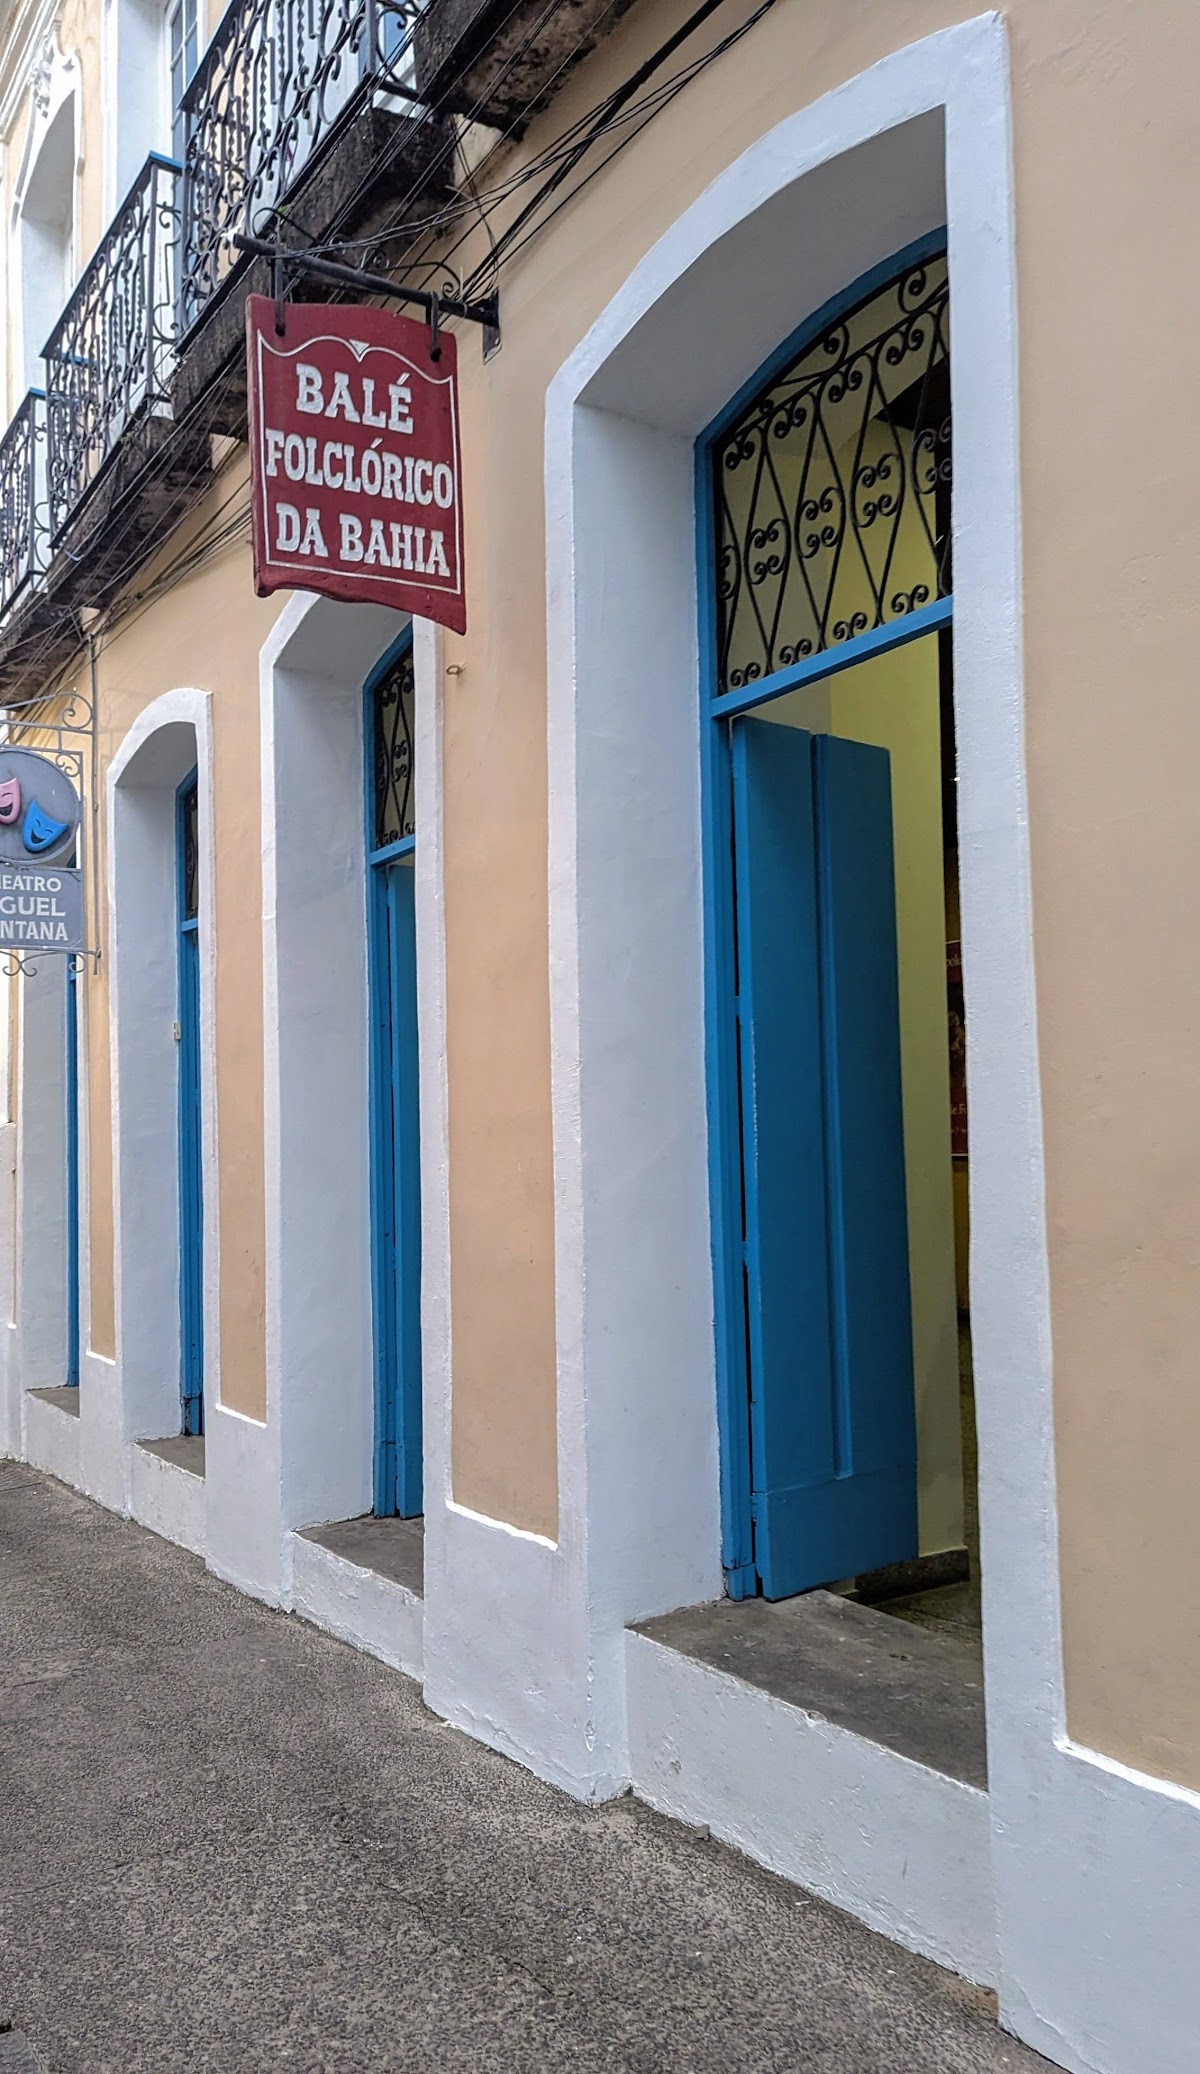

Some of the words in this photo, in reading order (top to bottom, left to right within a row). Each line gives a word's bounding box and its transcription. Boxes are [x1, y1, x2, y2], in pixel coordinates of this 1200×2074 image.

[296, 363, 413, 434] BALÉ
[265, 428, 454, 509] FOLCLÓRICO
[276, 503, 328, 558] DA
[339, 514, 450, 578] BAHIA
[0, 874, 62, 892] EATRO
[0, 896, 66, 917] GUEL
[0, 920, 69, 941] NTANA
